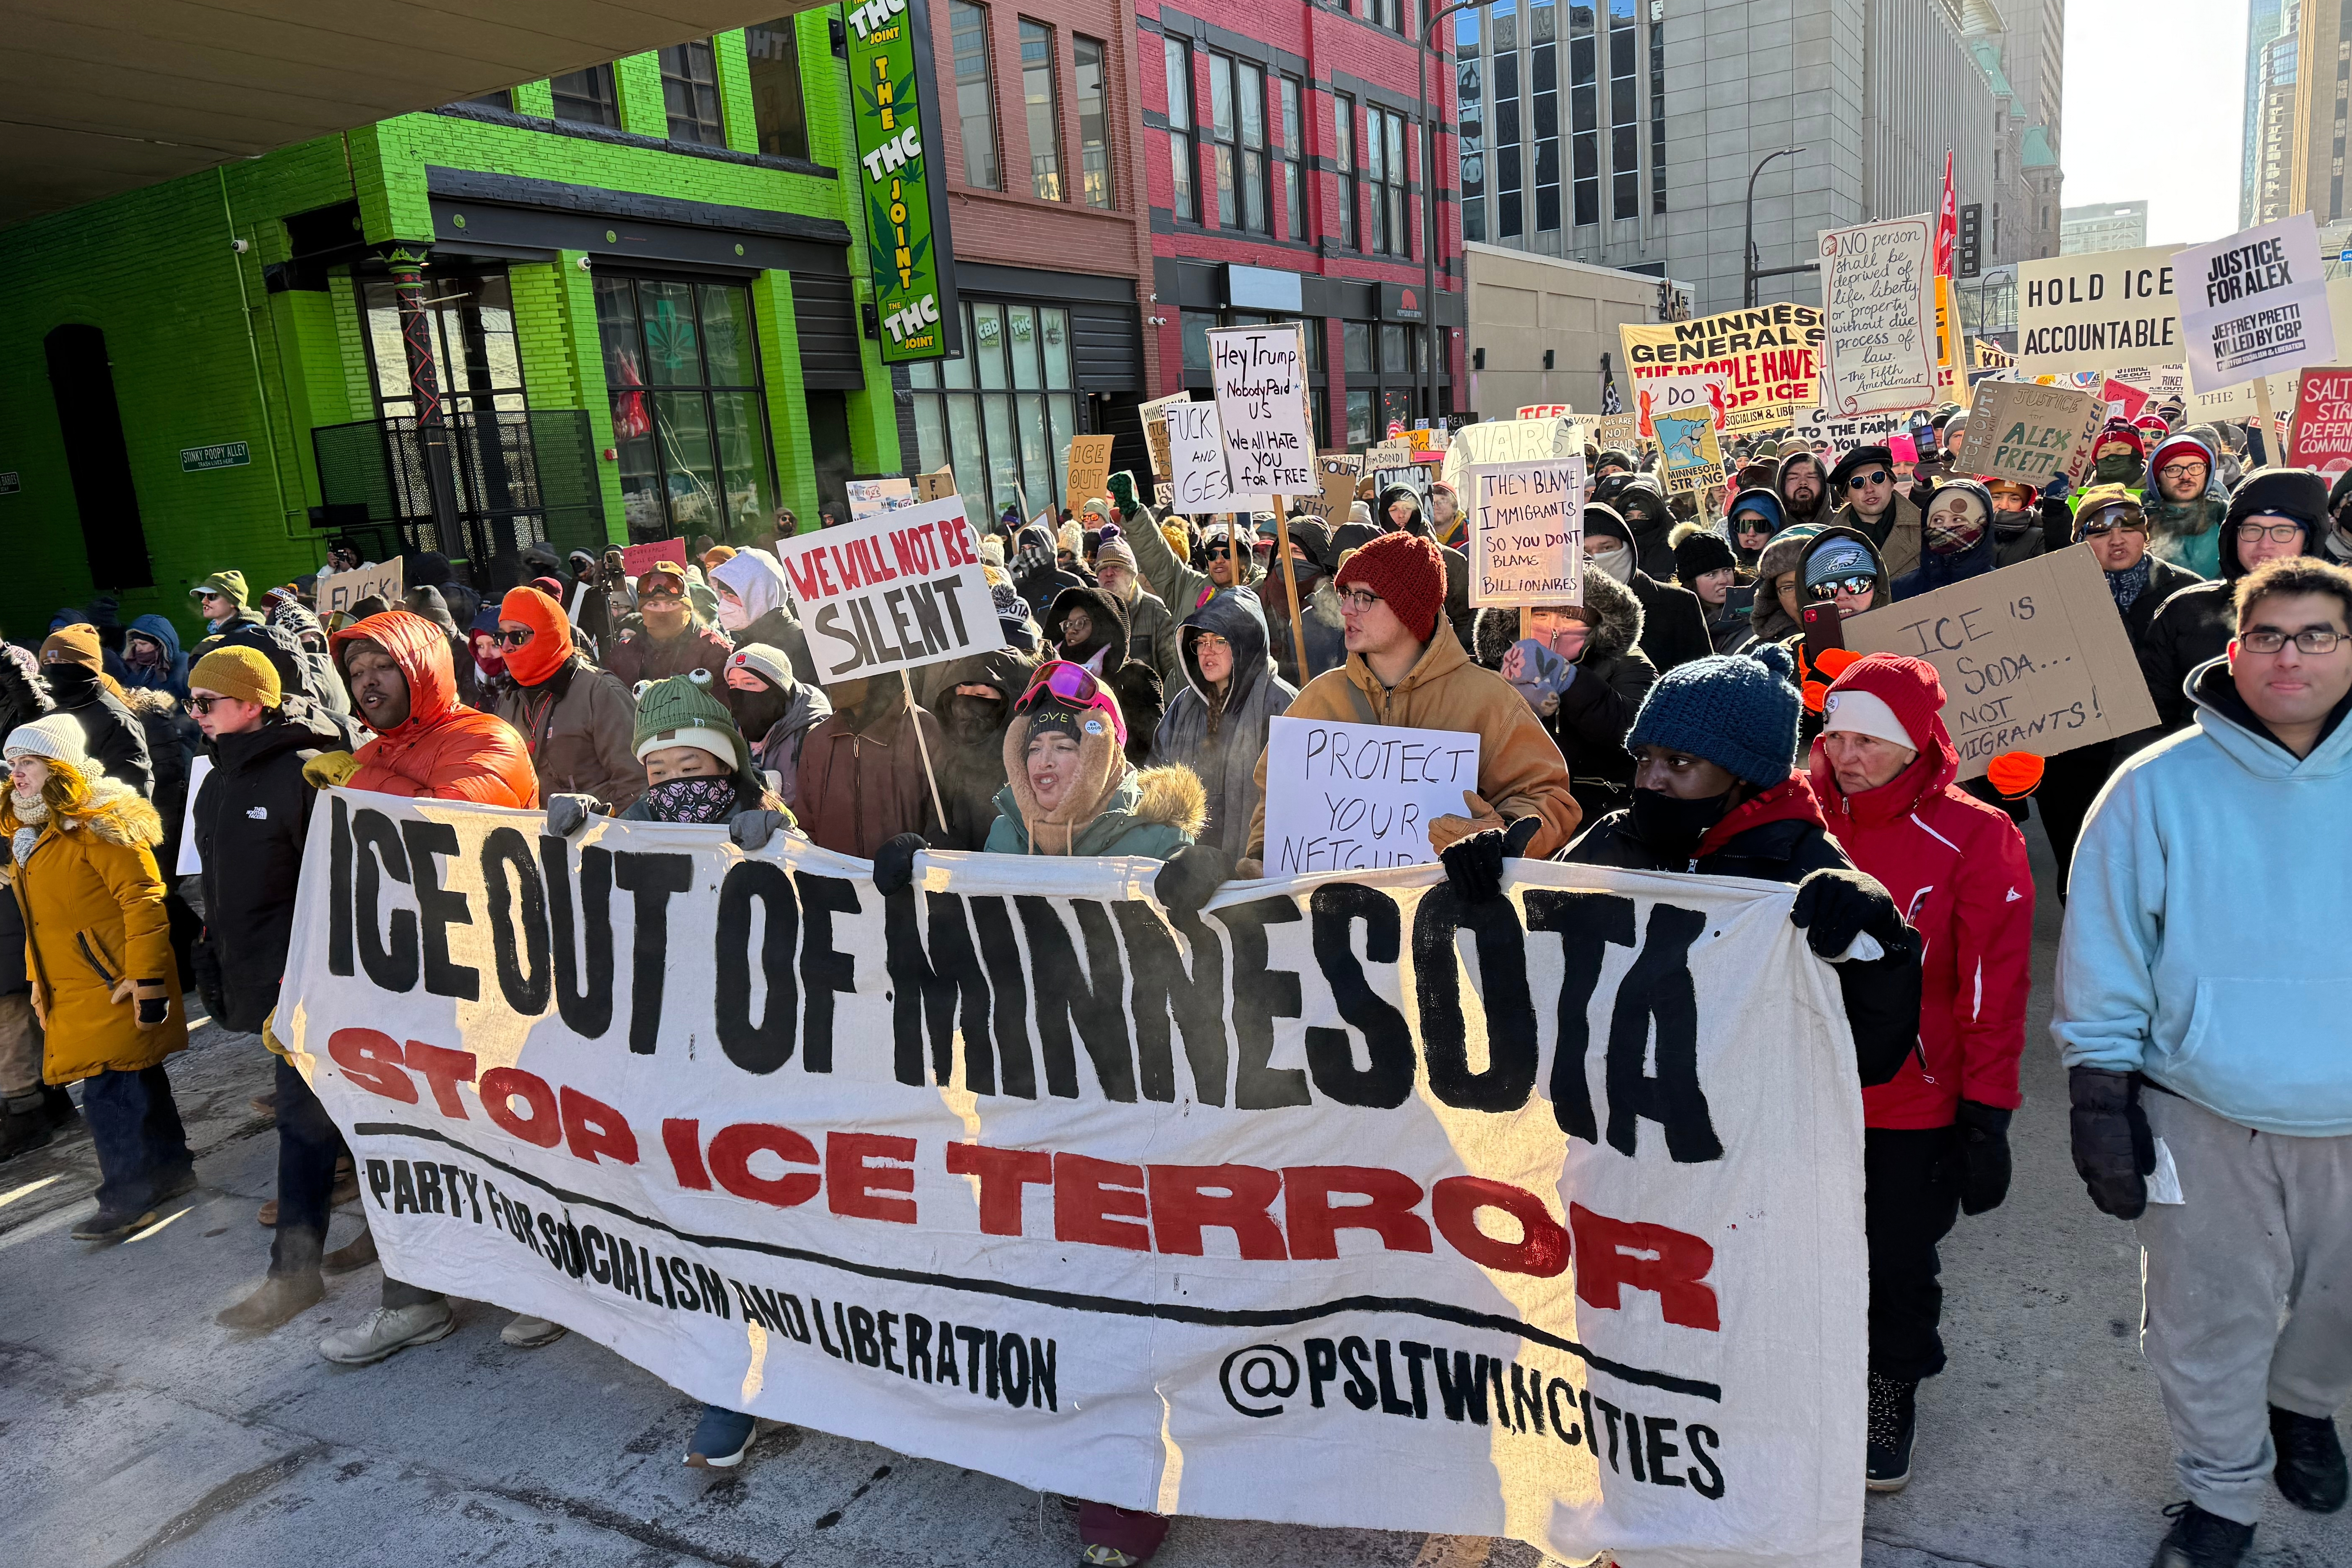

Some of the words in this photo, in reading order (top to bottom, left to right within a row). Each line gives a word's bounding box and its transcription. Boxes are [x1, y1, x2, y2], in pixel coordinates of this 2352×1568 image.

[849, 0, 905, 39] THC
[870, 26, 899, 44] JOINT
[874, 56, 894, 130] THE
[864, 125, 922, 182] THC
[890, 177, 911, 289] JOINT
[1837, 232, 1868, 257] NO
[1872, 229, 1920, 253] person
[1836, 253, 1877, 273] shall
[1887, 247, 1909, 263] be
[2207, 237, 2285, 282] JUSTICE
[1834, 263, 1890, 289] deprived
[1897, 260, 1914, 280] of
[2028, 273, 2104, 307] HOLD
[2124, 267, 2173, 300] ICE
[2206, 275, 2243, 308] FOR
[2245, 260, 2294, 296] ALEX
[1833, 289, 1865, 309] life,
[1869, 279, 1919, 301] liberty,
[884, 294, 939, 343] THC
[1831, 315, 1884, 333] without
[1889, 313, 1918, 327] due
[1832, 309, 1845, 320] or
[1850, 298, 1908, 322] property
[2212, 313, 2256, 341] JEFFREY
[2258, 303, 2300, 327] PRETTI
[978, 319, 999, 339] CBD
[1012, 317, 1031, 335] THC
[2024, 316, 2175, 355] ACCOUNTABLE
[905, 336, 933, 349] JOINT
[1631, 326, 1798, 362] GENERAL
[1836, 332, 1889, 358] process
[1898, 328, 1915, 352] of
[2213, 332, 2255, 359] KILLED
[2256, 327, 2273, 346] BY
[2275, 320, 2302, 341] CBP
[1217, 340, 1247, 383] Hey
[1246, 336, 1296, 377] Trump
[1761, 349, 1816, 383] HAVE
[1862, 346, 1896, 363] law.
[1856, 372, 1924, 392] Amendment
[1870, 364, 1904, 382] Fifth
[2161, 375, 2183, 386] RIKE!
[1227, 378, 1265, 405] Nobody
[1266, 378, 1290, 396] Paid
[1668, 387, 1695, 406] DO
[1767, 383, 1809, 401] ICE
[2013, 389, 2082, 414] JUSTICE
[2198, 391, 2233, 406] THE
[2305, 378, 2352, 403] SALT
[1249, 401, 1272, 419] US
[1520, 406, 1565, 419] ICE
[1604, 418, 1616, 427] WE
[1617, 417, 1633, 426] ARE
[1725, 410, 1763, 426] SOCIALISM
[1765, 409, 1774, 419] &
[2316, 401, 2352, 421] STR
[1167, 408, 1213, 443] FUCK
[1604, 427, 1630, 439] NOT
[1798, 426, 1821, 439] TO
[1827, 423, 1856, 437] THE
[1860, 419, 1898, 435] FARM
[1960, 435, 1983, 469] ICE
[1973, 386, 1998, 431] OUT!
[2002, 422, 2072, 451] ALEX
[1227, 429, 1249, 450] We
[1602, 439, 1636, 451] AFRAID
[1833, 438, 1861, 452] YOU
[2068, 445, 2088, 490] FUCK
[2082, 403, 2103, 443] ICE!
[183, 450, 203, 463] STINKY
[204, 447, 225, 460] POOPY
[227, 443, 245, 457] ALLEY
[1074, 445, 1105, 464] ICE
[1192, 450, 1216, 463] AND
[1378, 453, 1403, 463] BONDI
[1993, 445, 2063, 476] PRETTI
[1070, 469, 1103, 489] OUT
[1273, 468, 1308, 486] FREE
[1320, 459, 1361, 477] YOUR
[1667, 463, 1722, 480] MINNESOTA
[1156, 483, 1172, 496] ICE
[1481, 474, 1527, 497] THEY
[1533, 469, 1579, 495] BLAME
[1477, 501, 1576, 530] IMMIGRANTS
[1486, 536, 1506, 553] SO
[1511, 535, 1540, 550] YOU
[1545, 530, 1581, 548] DONT
[784, 546, 838, 602] WE
[831, 535, 898, 592] WILL
[888, 523, 940, 577] NOT
[938, 516, 978, 568] BE
[1492, 554, 1539, 568] BLAME
[815, 574, 970, 675] SILENT
[1897, 607, 1993, 657] ICE
[2009, 596, 2036, 620] IS
[1960, 696, 2013, 729] NOT
[1306, 728, 1474, 784] PROTECT
[1324, 792, 1420, 844] YOUR
[328, 795, 480, 1002] ICE
[480, 826, 695, 1055] OUT
[714, 860, 862, 1075] OF
[883, 881, 1724, 1163] MINNESOTA
[327, 1027, 640, 1166] STOP
[662, 1117, 918, 1224] ICE
[946, 1141, 1720, 1331] TERROR
[366, 1158, 483, 1224] PARTY
[484, 1179, 542, 1258] FOR
[539, 1205, 731, 1320] SOCIALISM
[728, 1277, 812, 1345] AND
[810, 1297, 1057, 1412] LIBERATION
[1219, 1336, 1726, 1500] @PSLTWINCITIES
